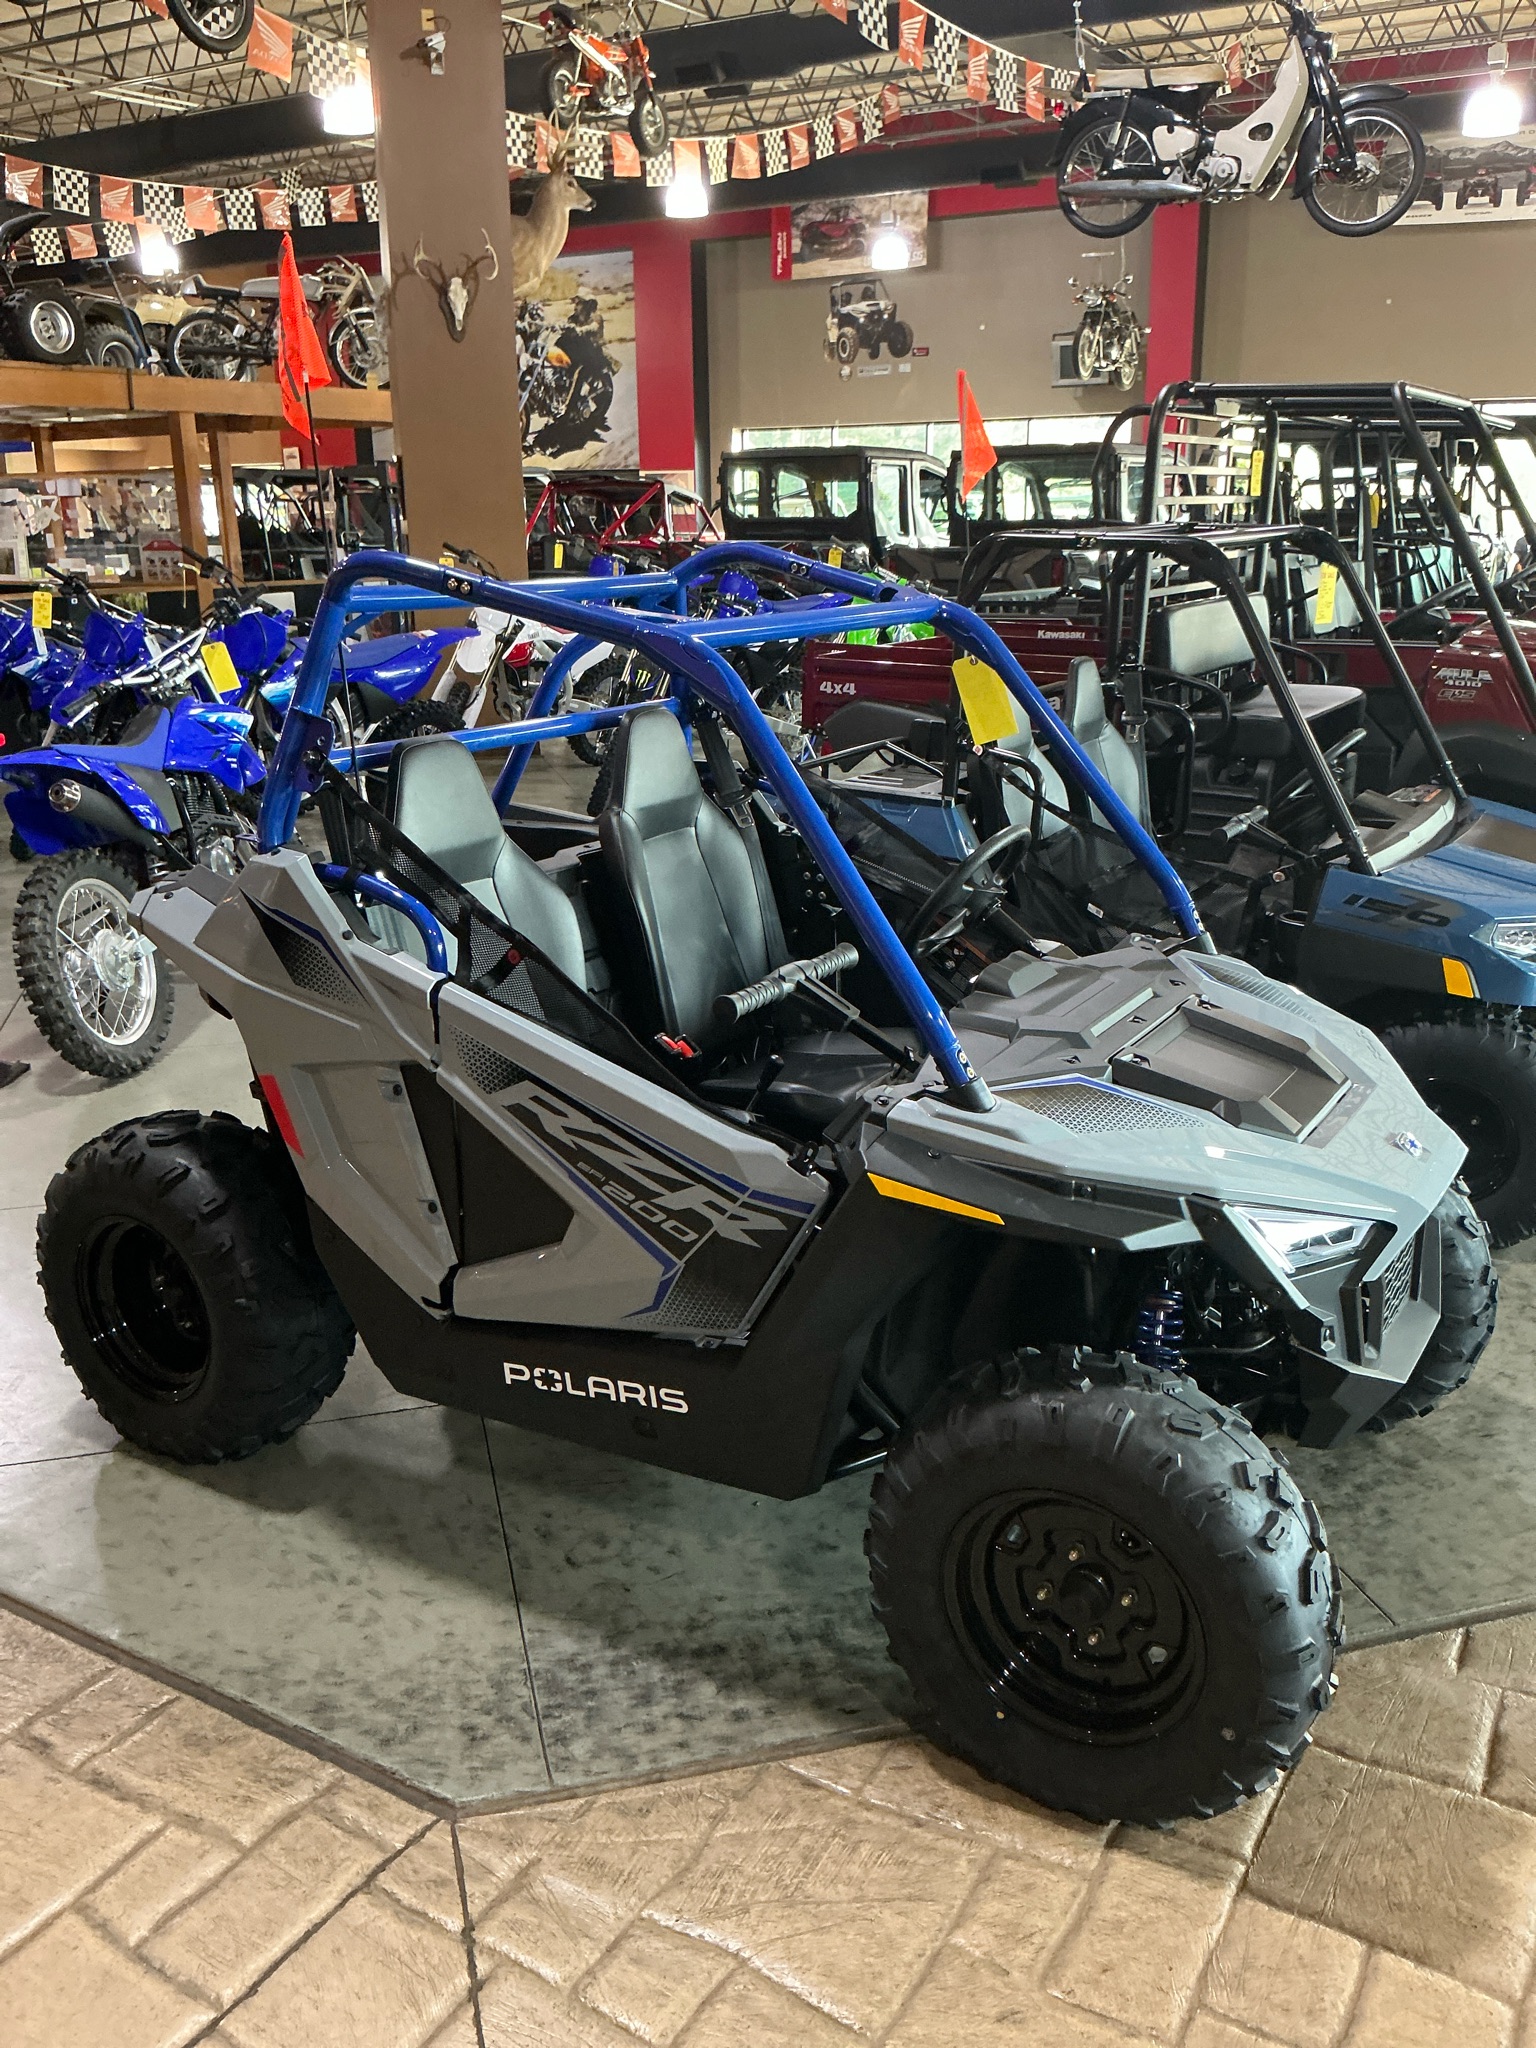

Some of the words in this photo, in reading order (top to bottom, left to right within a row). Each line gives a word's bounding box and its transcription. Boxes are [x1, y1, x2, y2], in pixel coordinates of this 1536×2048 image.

[1037, 629, 1086, 640] Kawasaki
[1433, 667, 1493, 684] MULE
[1444, 680, 1482, 688] 4010
[498, 1079, 788, 1249] RZR
[602, 1180, 699, 1243] 200
[502, 1361, 690, 1415] POLARIS
